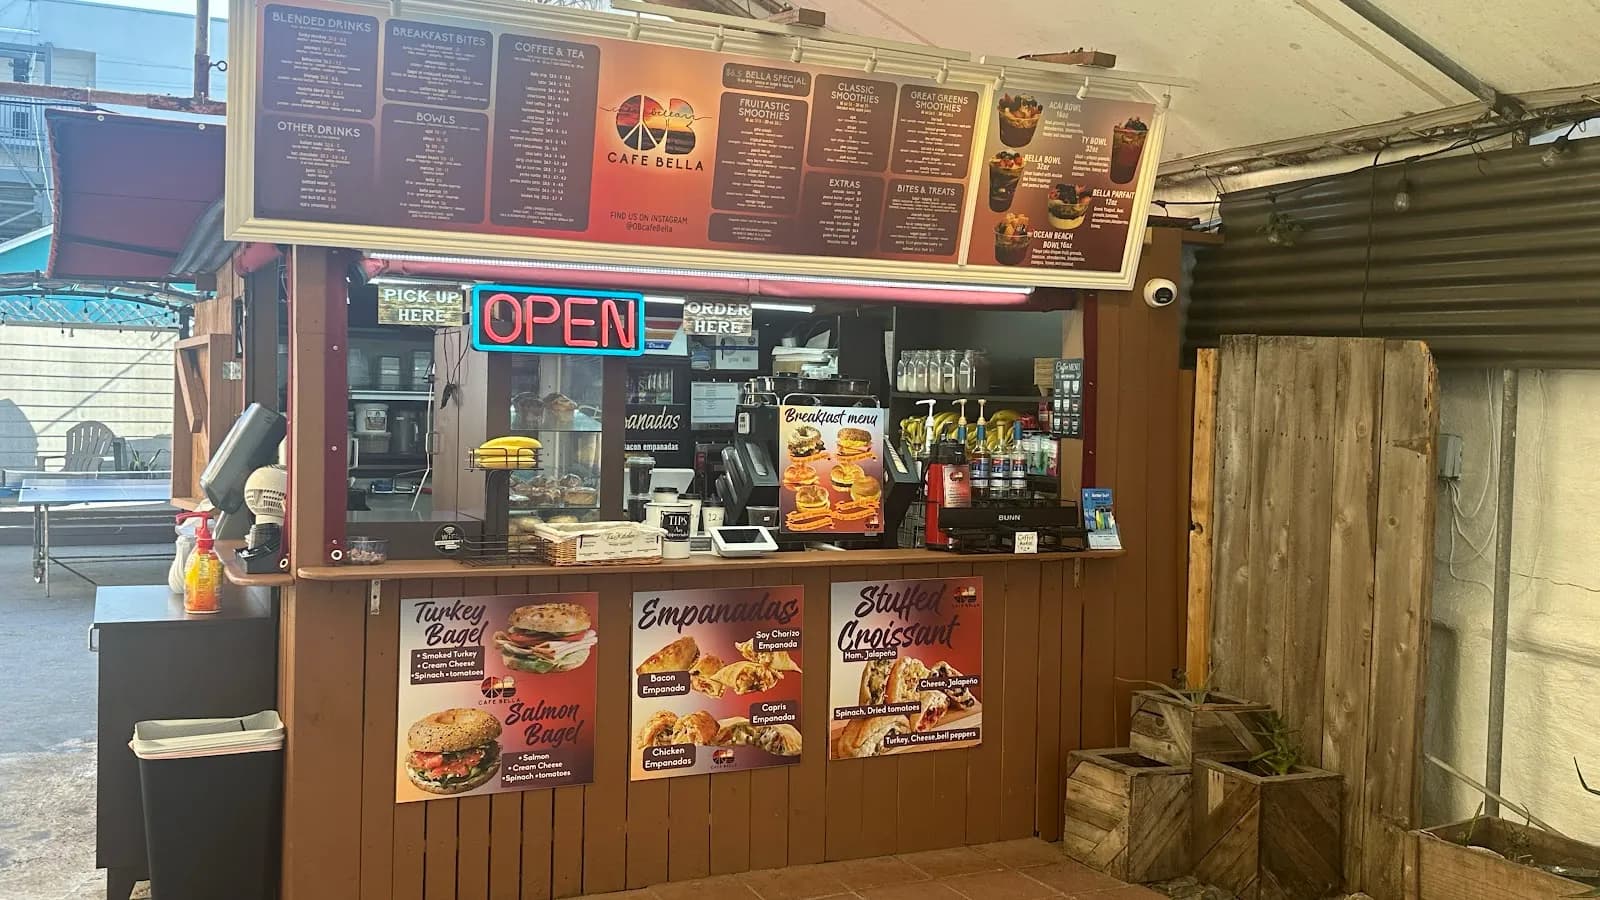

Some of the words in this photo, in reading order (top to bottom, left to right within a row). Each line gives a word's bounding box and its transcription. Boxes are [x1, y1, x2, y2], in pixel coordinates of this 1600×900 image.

[272, 12, 326, 26] BLENDED
[328, 19, 372, 32] DRINKS
[392, 26, 455, 42] BREAKFAST
[456, 34, 486, 46] BITES
[514, 42, 554, 56] COFFEE
[556, 48, 564, 56] &
[567, 48, 584, 59] TEA
[745, 70, 771, 80] BELLA
[773, 73, 806, 86] SPECIAL
[838, 82, 874, 94] CLASSIC
[831, 90, 880, 104] SMOOTHIES
[910, 91, 936, 100] GREAT
[937, 94, 968, 104] GREENS
[740, 98, 790, 112] FRUITASTIC
[916, 101, 962, 112] SMOOTHIES
[1064, 104, 1082, 112] BOWL
[416, 112, 456, 124] BOWLS
[738, 108, 790, 120] SMOOTHIES
[277, 121, 315, 134] OTHER
[318, 125, 360, 138] DRINKS
[1090, 138, 1108, 146] BOWL
[608, 152, 648, 166] CAFE
[656, 156, 704, 171] BELLA
[1024, 154, 1042, 163] BELLA
[1044, 156, 1062, 164] BOWL
[829, 178, 861, 189] EXTRAS
[896, 184, 919, 194] BITES
[920, 186, 926, 194] &
[928, 187, 956, 196] TREATS
[1092, 189, 1111, 197] BELLA
[1111, 190, 1134, 199] PARFAIT
[610, 212, 627, 220] FIND
[628, 212, 638, 221] US
[639, 213, 649, 222] ON
[650, 214, 688, 224] INSTAGRAM
[1034, 230, 1053, 239] OCEAN
[1053, 232, 1073, 240] BEACH
[1043, 240, 1059, 249] BOWL
[384, 288, 431, 303] PICK
[436, 290, 461, 302] UP
[398, 308, 446, 322] HERE
[687, 302, 750, 316] ORDER
[484, 293, 636, 348] OPEN
[694, 320, 742, 334] HERE
[784, 408, 846, 426] Breakfast
[848, 412, 878, 427] menu
[643, 442, 679, 453] empanadas
[668, 515, 688, 526] TIPS
[854, 583, 947, 622] Stuffed
[414, 600, 488, 625] Turkey
[638, 592, 799, 634] Empanadas
[425, 621, 489, 648] Bagel
[756, 631, 770, 639] Soy
[771, 629, 800, 638] Chorizo
[837, 614, 960, 652] Croissant
[759, 640, 798, 651] Empanada
[422, 651, 452, 660] Smoked
[454, 650, 477, 659] Turkey
[864, 650, 896, 659] Jalapeño
[449, 660, 475, 668] Cheese
[414, 671, 444, 680] Spinach
[450, 669, 484, 677] tomatoes
[651, 674, 676, 682] Bacon
[948, 677, 978, 687] Jalapeño
[642, 684, 686, 695] Empanada
[505, 700, 579, 726] Salmon
[762, 703, 786, 713] Capris
[868, 706, 886, 715] Dried
[888, 704, 920, 712] tomatoes
[753, 714, 796, 724] Empanadas
[525, 720, 584, 748] Bagel
[950, 731, 976, 740] peppers
[652, 747, 685, 756] Chicken
[512, 764, 536, 772] Cream
[538, 761, 563, 769] Cheese
[645, 757, 692, 770] Empanadas
[505, 774, 534, 783] Spinach
[538, 770, 570, 779] tomatoes
